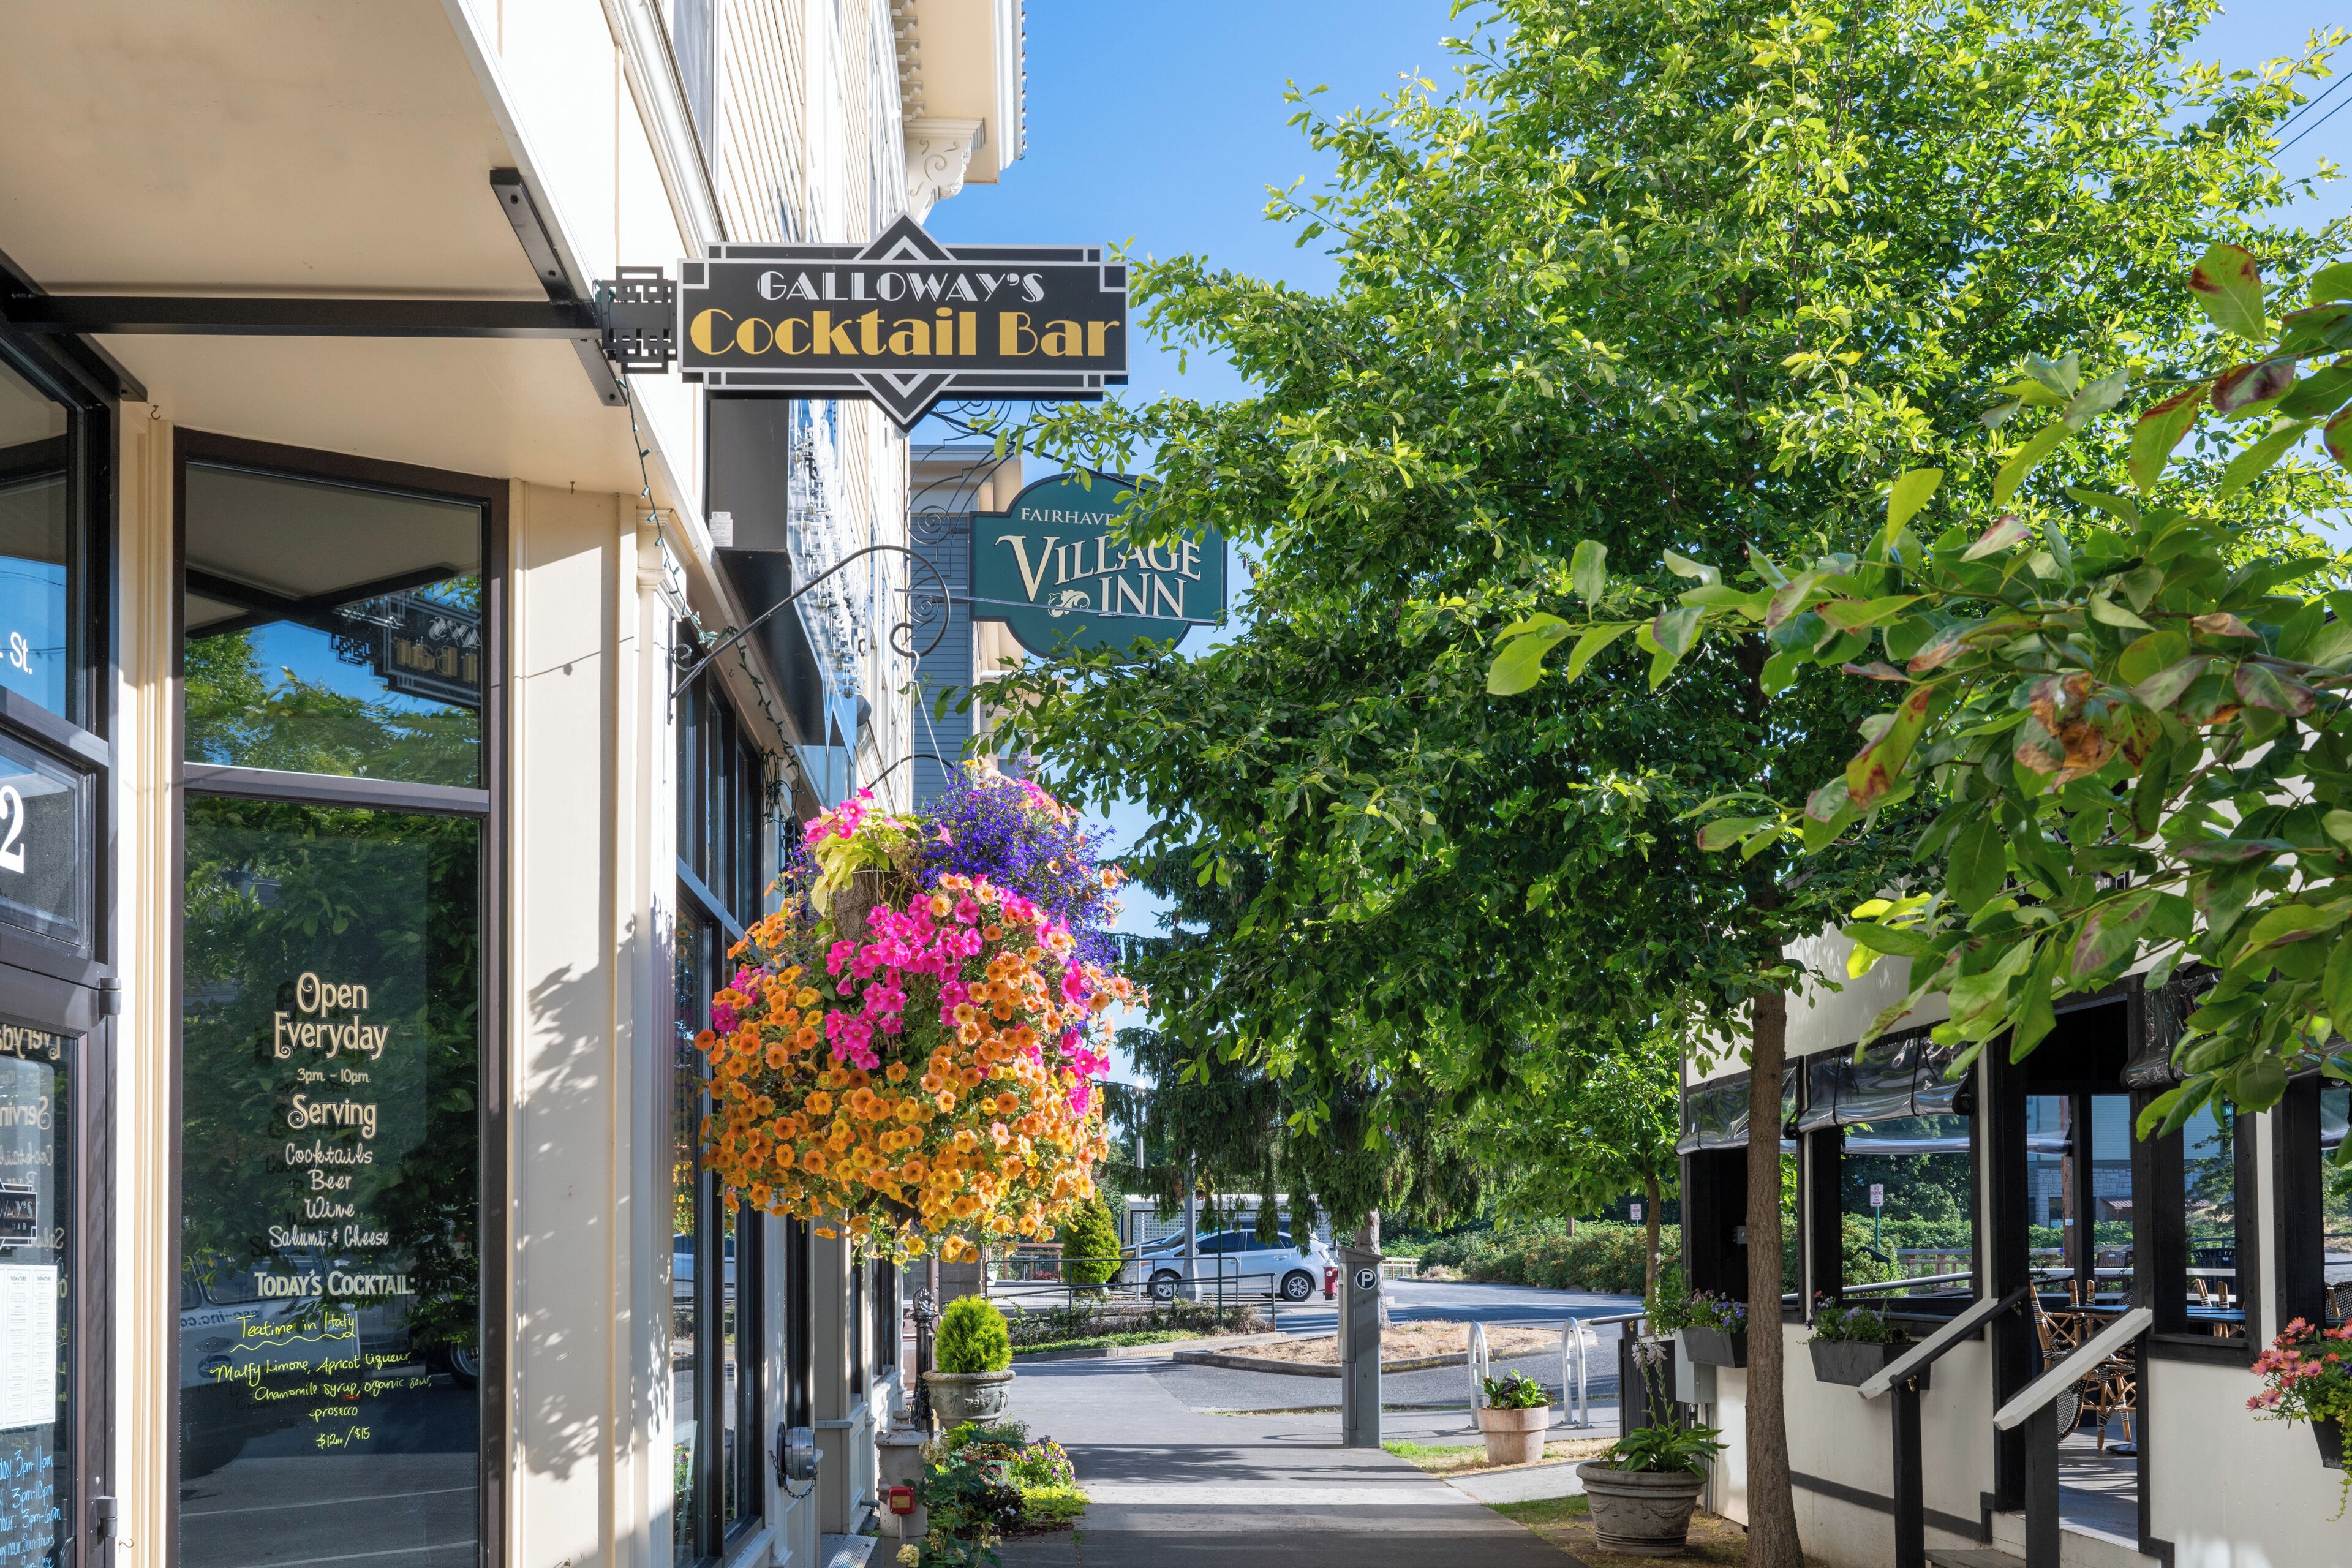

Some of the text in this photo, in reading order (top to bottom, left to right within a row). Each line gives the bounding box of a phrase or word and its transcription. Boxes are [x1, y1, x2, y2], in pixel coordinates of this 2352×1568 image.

[757, 271, 1044, 302] GALLOWAY'S
[690, 307, 1120, 356] Cocktail Bar
[995, 535, 1202, 602] VILLAGE
[1098, 573, 1187, 617] INN
[10, 631, 32, 674] St.
[296, 972, 368, 1017] Open
[274, 1011, 390, 1060] Everyday
[297, 1068, 326, 1084] 3pm
[341, 1068, 370, 1085] 10pm
[288, 1094, 377, 1139] Serving
[286, 1140, 373, 1164] Cocktails
[307, 1169, 352, 1190] Beer
[304, 1196, 355, 1219] Wine
[269, 1224, 390, 1248] Salumi & Cheese
[1362, 1272, 1374, 1287] P
[236, 1311, 354, 1338] Teatime in Italy
[316, 1355, 360, 1375] Apricot
[255, 1382, 317, 1400] Chamomile
[324, 1382, 360, 1397] syrup,
[364, 1378, 404, 1397] organic
[309, 1406, 358, 1423] prosecco
